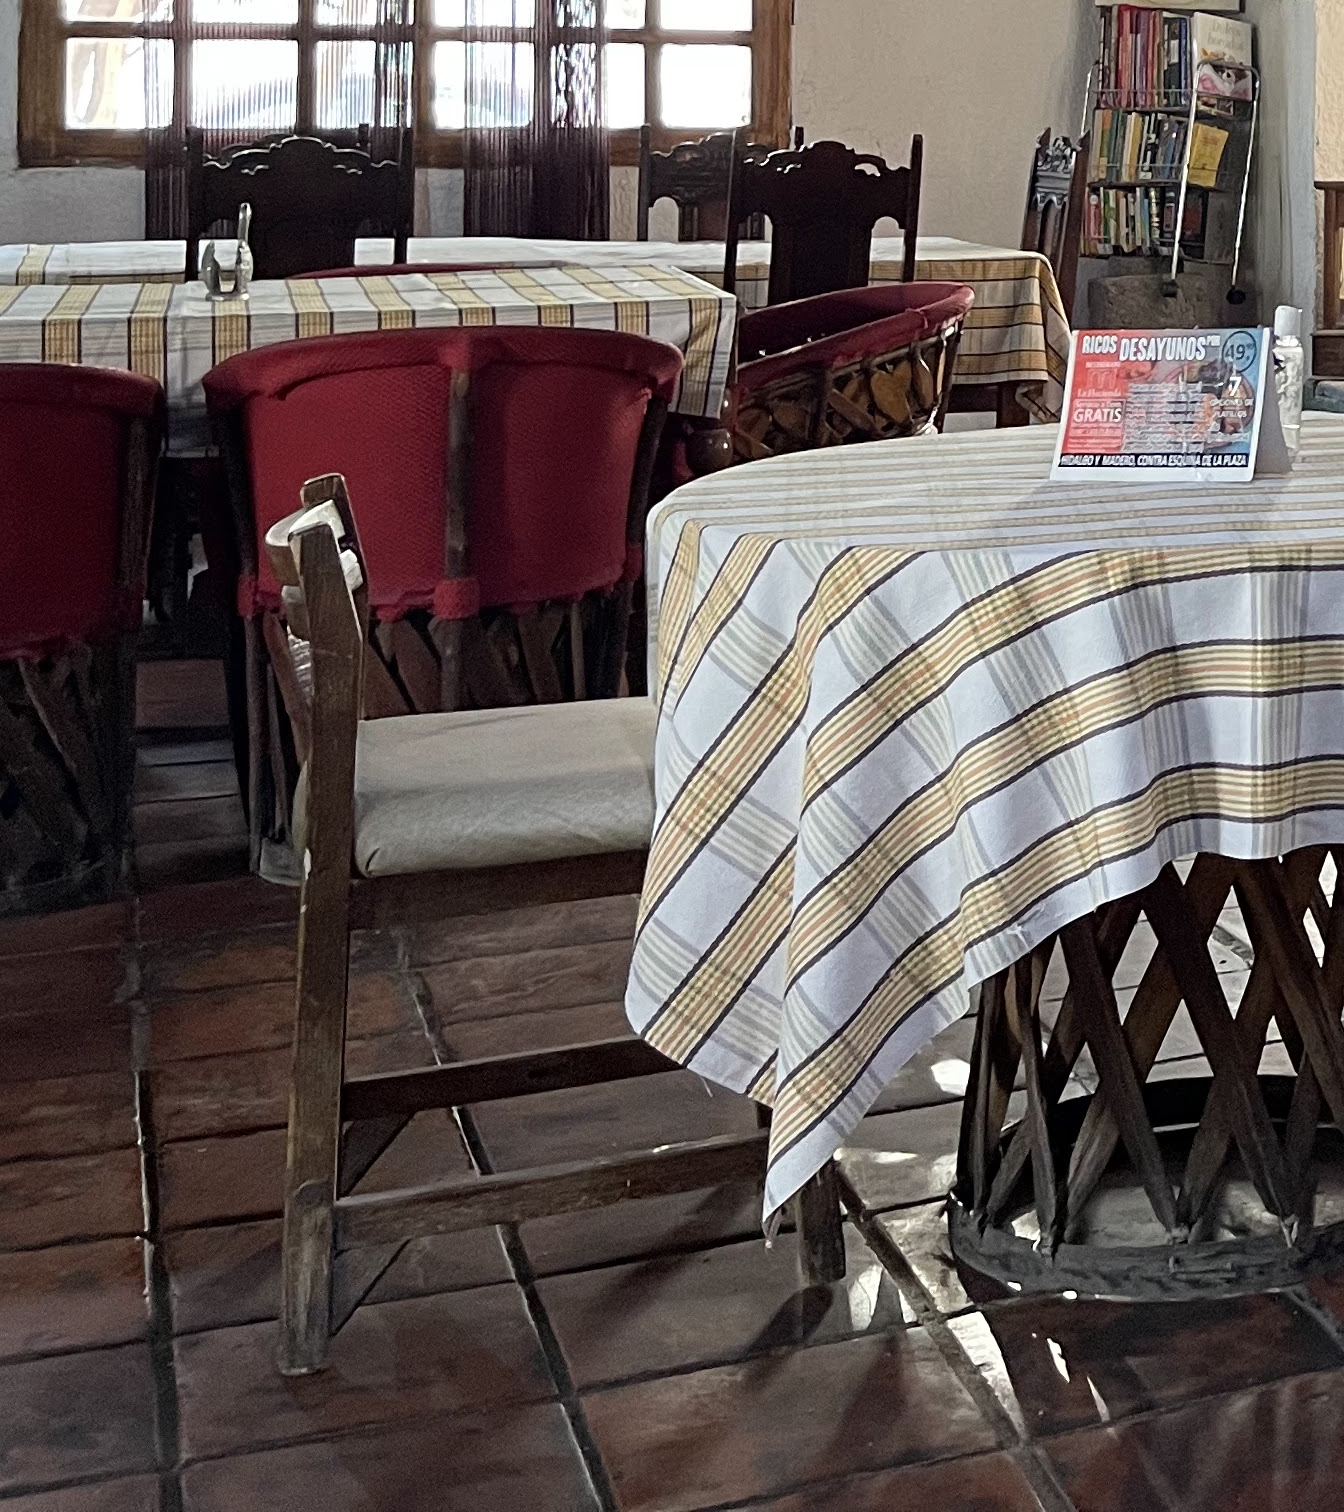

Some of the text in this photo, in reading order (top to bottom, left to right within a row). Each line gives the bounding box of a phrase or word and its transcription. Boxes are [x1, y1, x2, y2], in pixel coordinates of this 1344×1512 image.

[1081, 335, 1118, 355] RICOS
[1118, 336, 1207, 362] DESAYUNOS
[1229, 376, 1242, 397] 7
[1072, 408, 1123, 423] GRATIS
[1223, 454, 1247, 467] PLAZA
